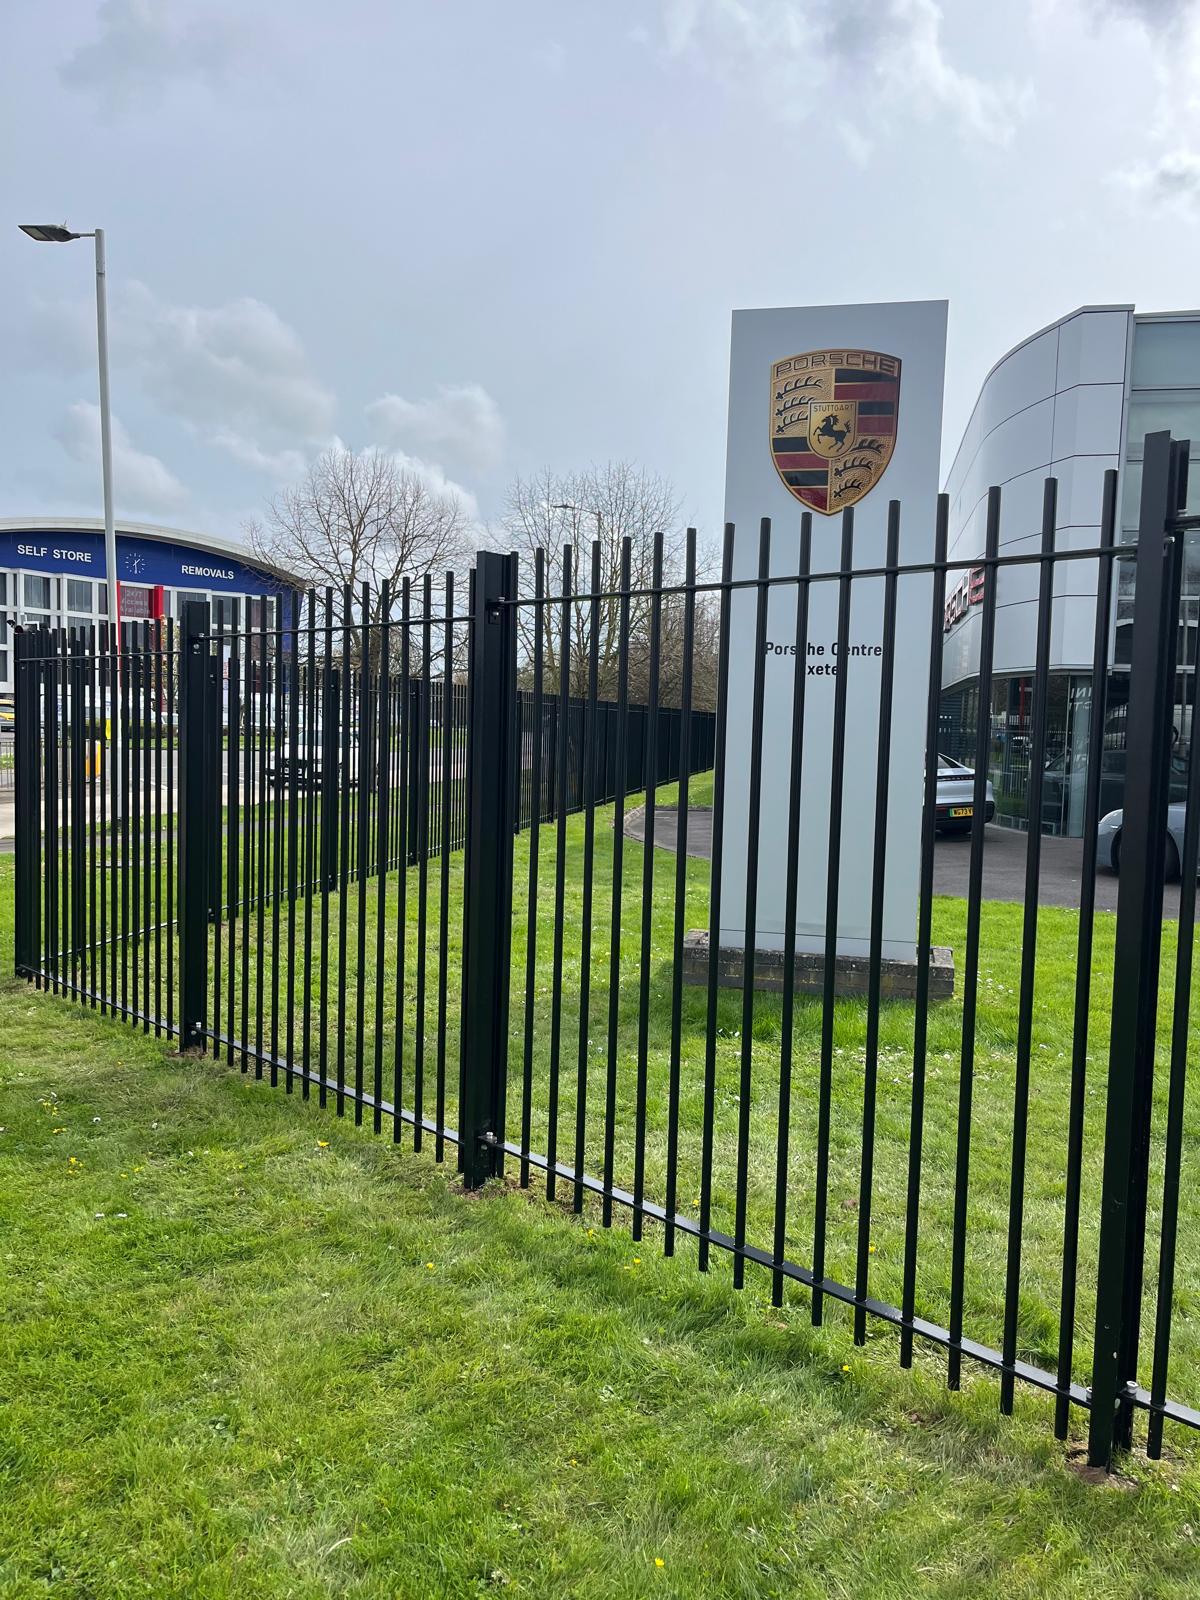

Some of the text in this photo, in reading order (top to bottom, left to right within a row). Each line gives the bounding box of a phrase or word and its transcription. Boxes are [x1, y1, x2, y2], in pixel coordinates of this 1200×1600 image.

[775, 353, 897, 378] PORSCHE
[813, 404, 854, 413] STUTTGART
[17, 544, 92, 563] SELF STORE
[181, 565, 235, 580] REMOVALS
[765, 642, 825, 656] Porshe
[807, 664, 838, 675] xete
